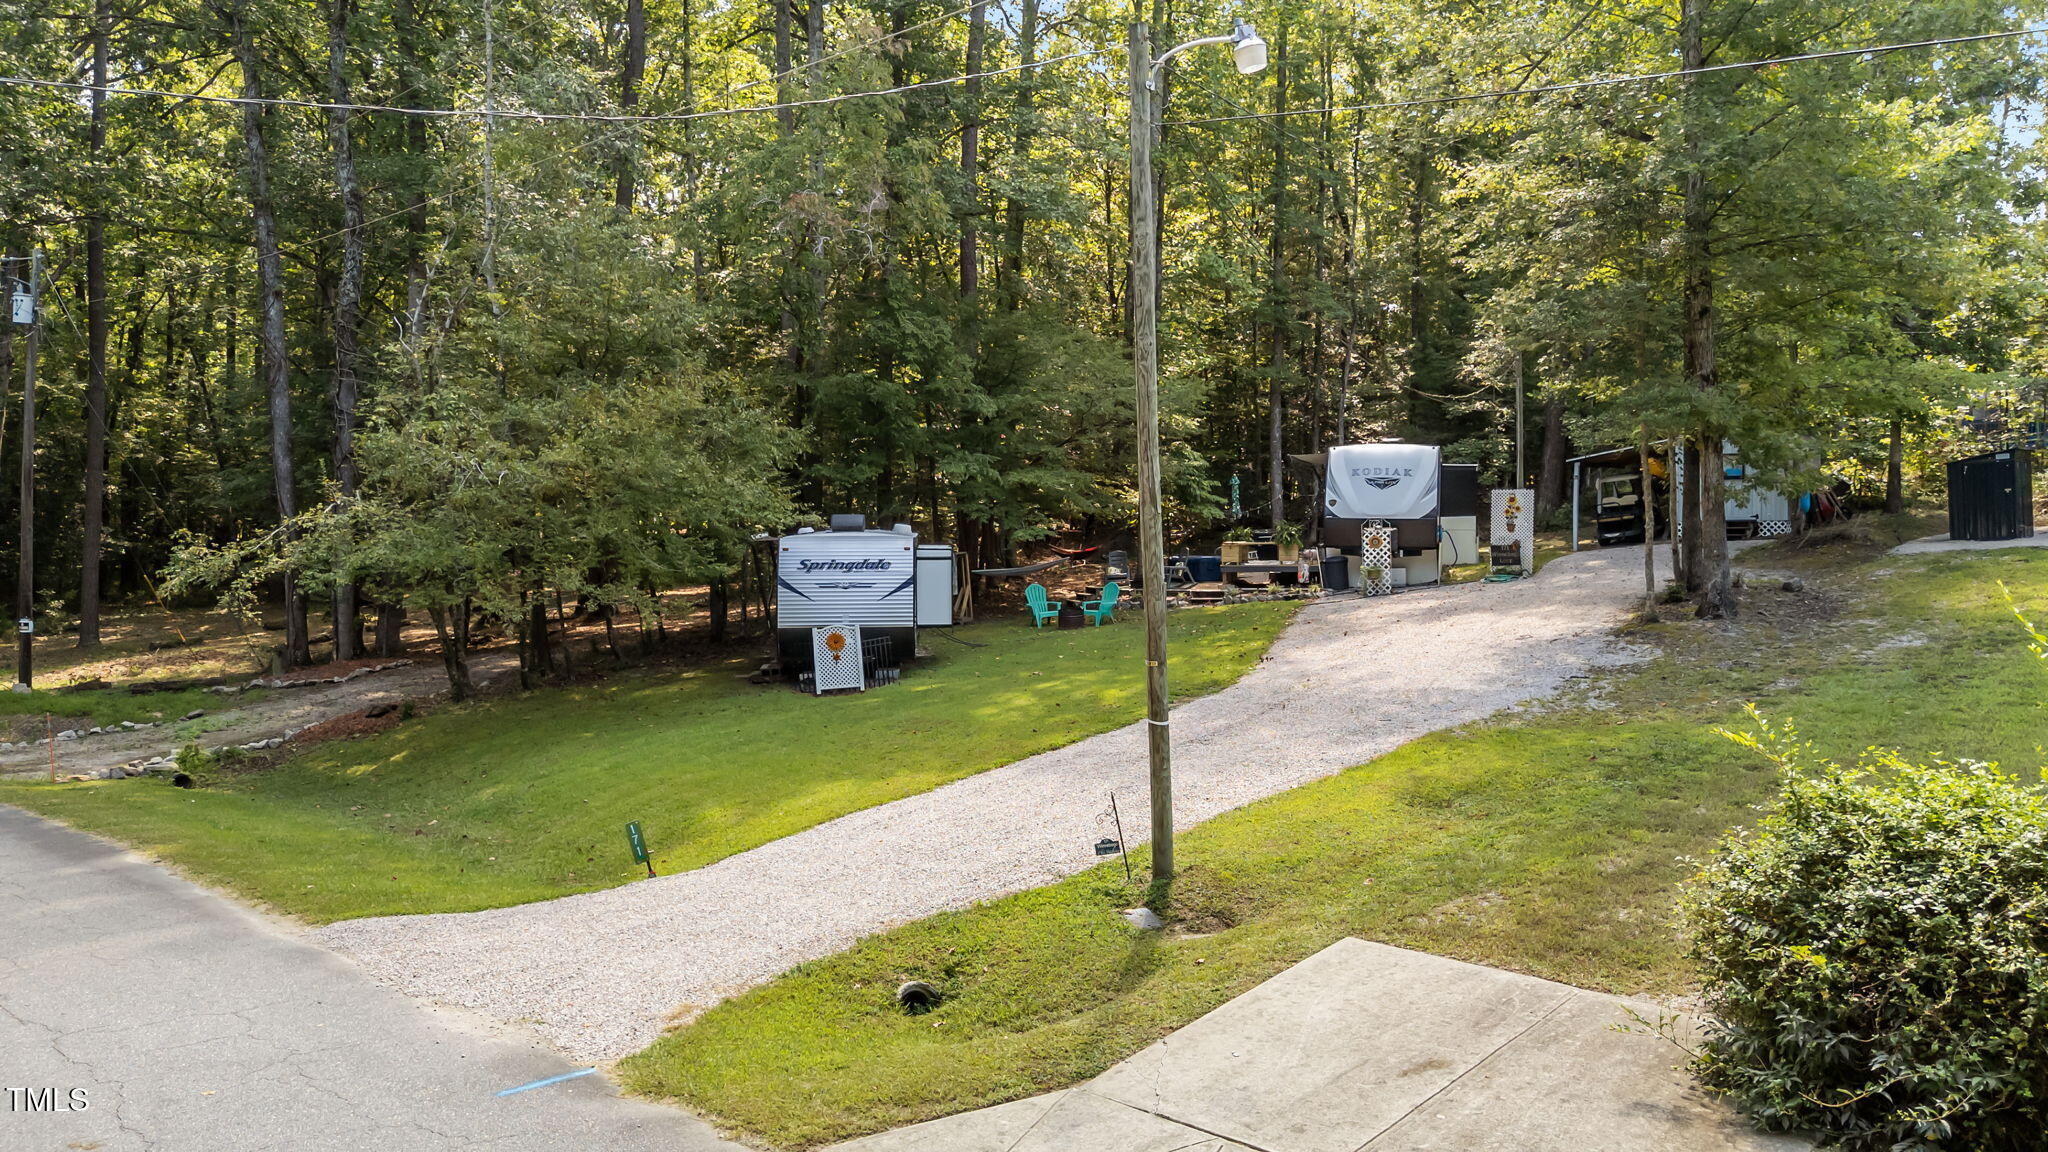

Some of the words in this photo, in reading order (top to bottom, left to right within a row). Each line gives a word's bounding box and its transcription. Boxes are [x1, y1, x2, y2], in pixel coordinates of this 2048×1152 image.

[1352, 467, 1414, 477] KODIAK
[797, 558, 892, 573] Springdale
[630, 825, 642, 856] 171
